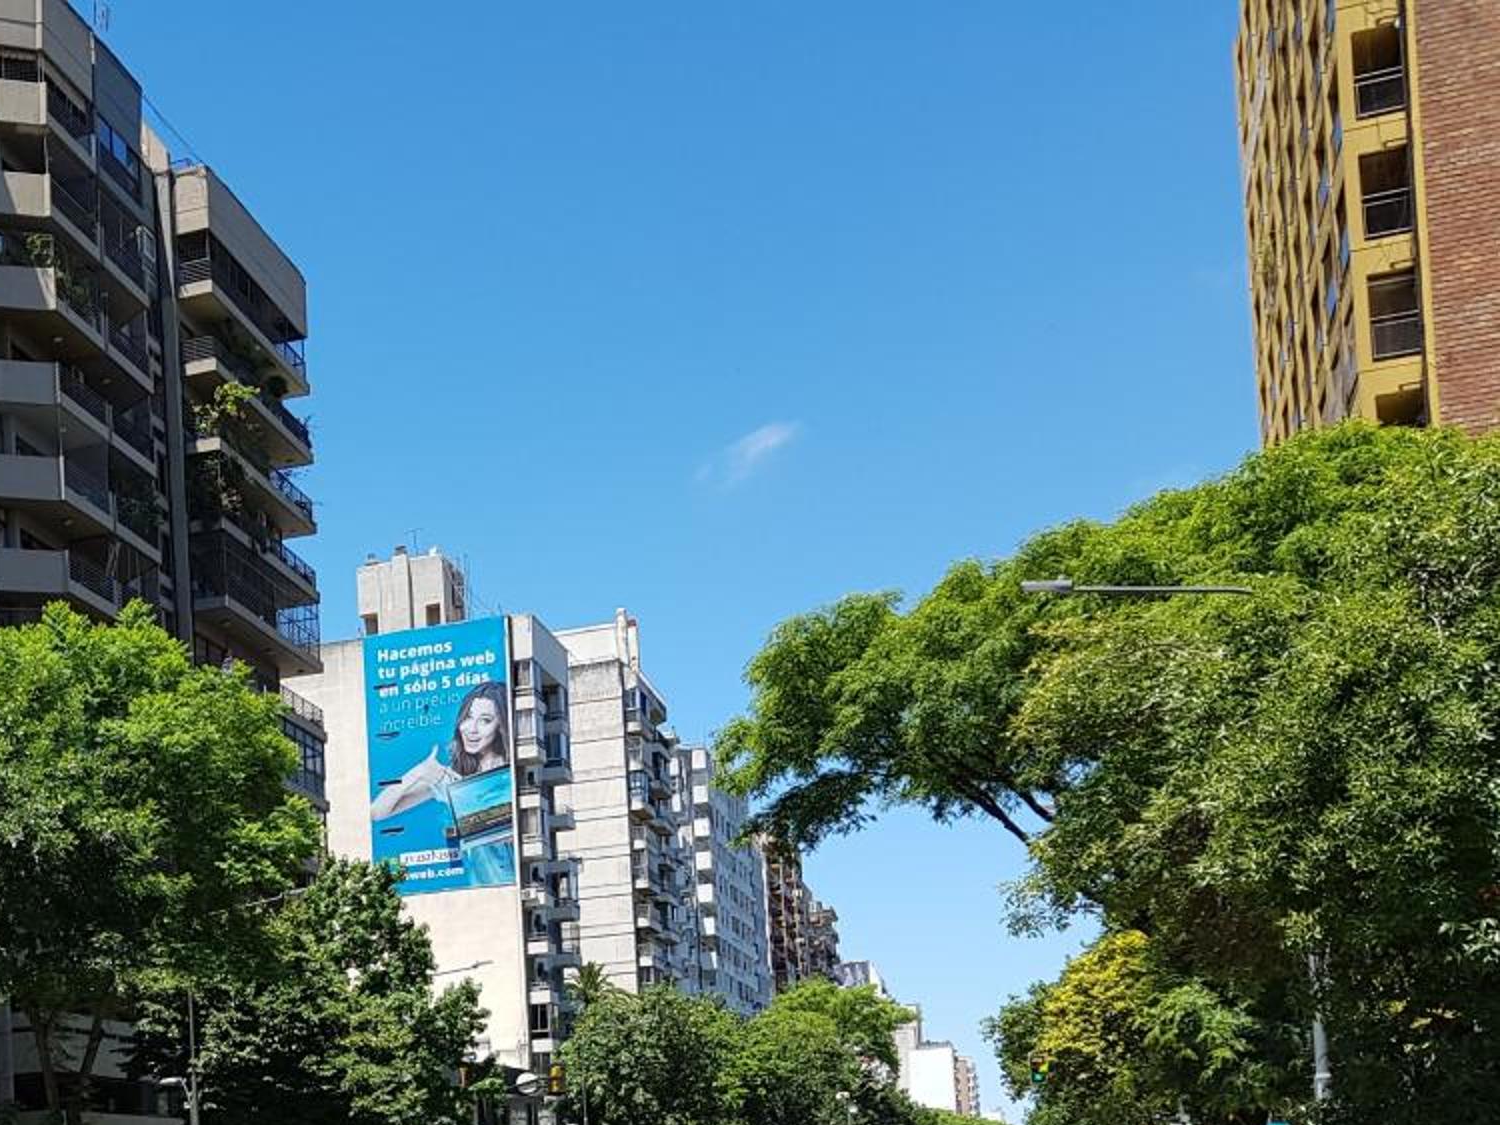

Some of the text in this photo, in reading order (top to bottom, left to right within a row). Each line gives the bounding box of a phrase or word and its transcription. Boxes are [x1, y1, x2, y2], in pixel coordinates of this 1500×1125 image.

[377, 641, 452, 663] Hacemos
[378, 650, 496, 680] tu página web
[379, 685, 399, 697] en
[403, 679, 437, 695] sólo
[441, 675, 451, 689] 5
[393, 699, 411, 712] un
